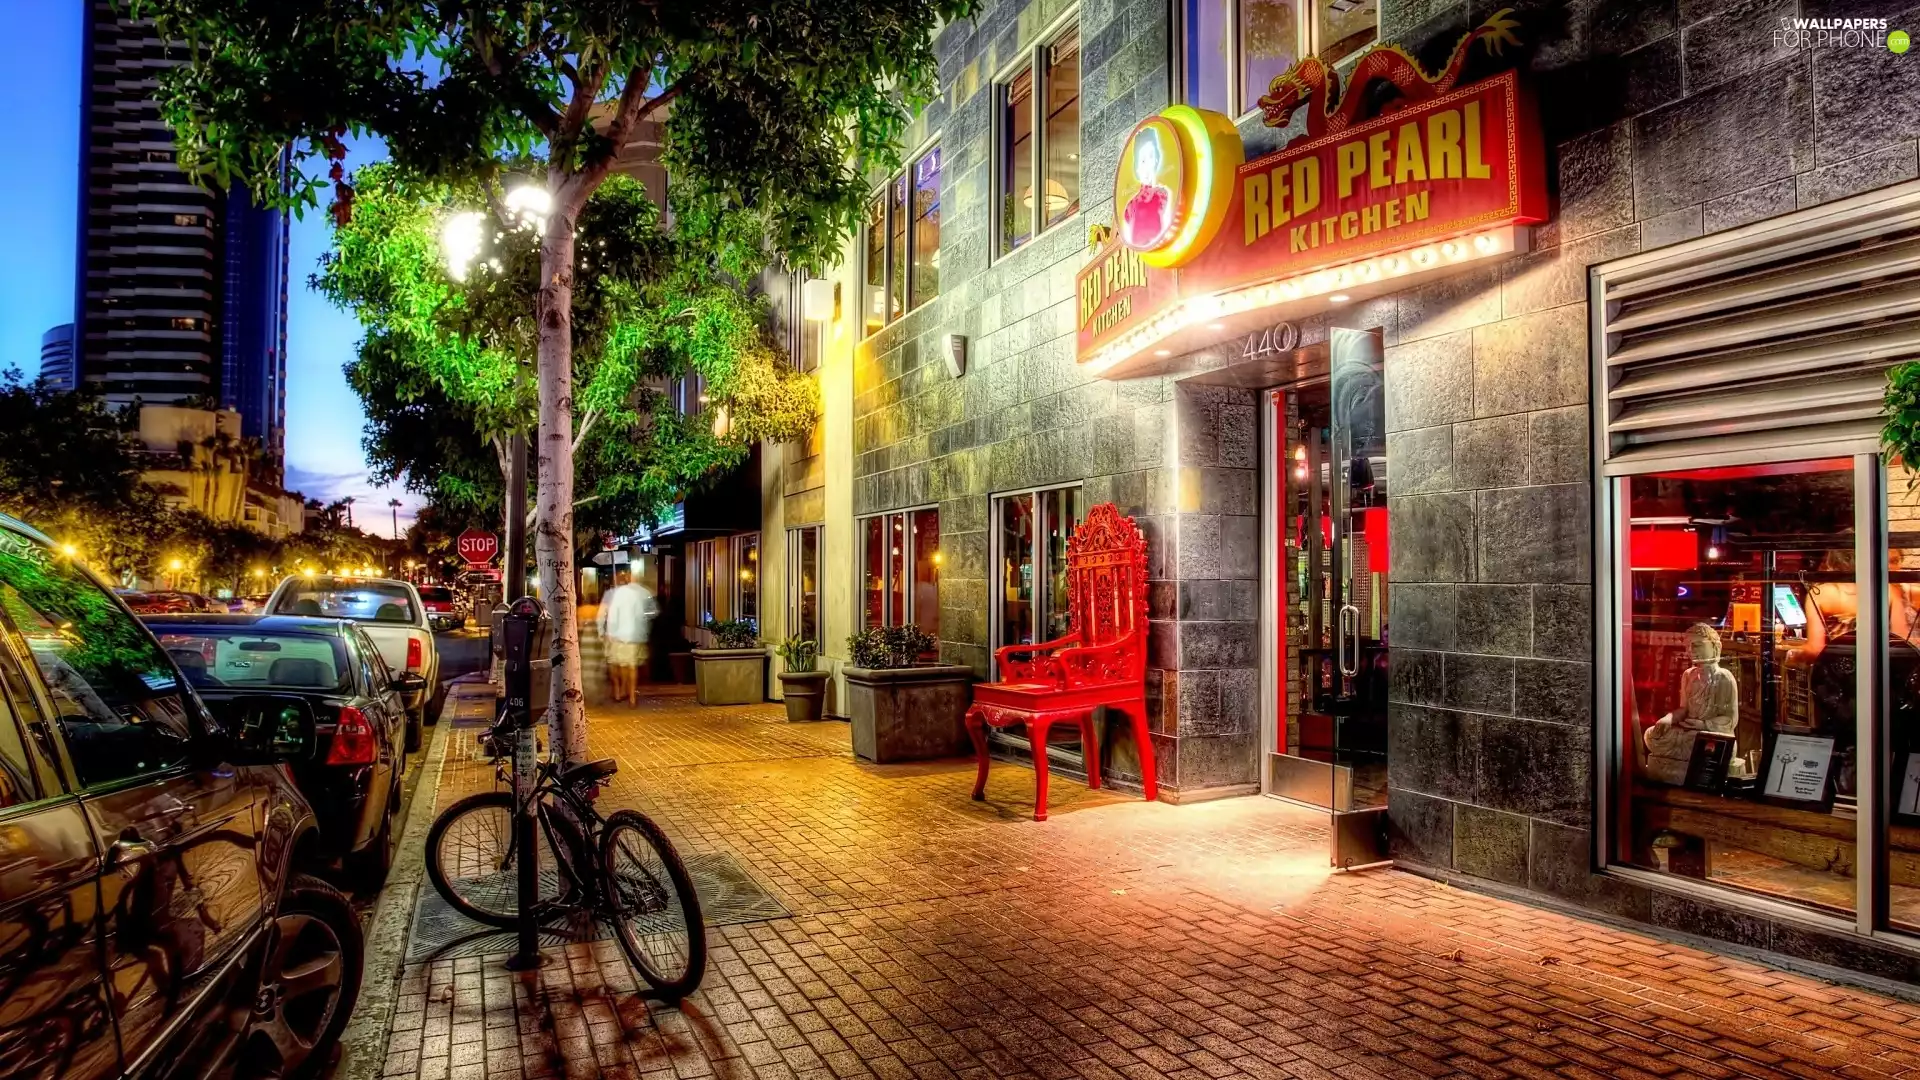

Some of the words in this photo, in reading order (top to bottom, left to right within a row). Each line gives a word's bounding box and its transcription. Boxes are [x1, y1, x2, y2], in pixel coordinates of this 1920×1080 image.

[1244, 156, 1320, 246] RED
[1337, 100, 1490, 199] PEARL
[1290, 190, 1429, 254] KITCHEN
[1080, 266, 1102, 332] RED
[1104, 246, 1148, 299] PEARL
[1092, 294, 1132, 338] KITCHEN
[1242, 322, 1292, 361] 440
[461, 538, 495, 552] STOP
[509, 697, 524, 707] 406
